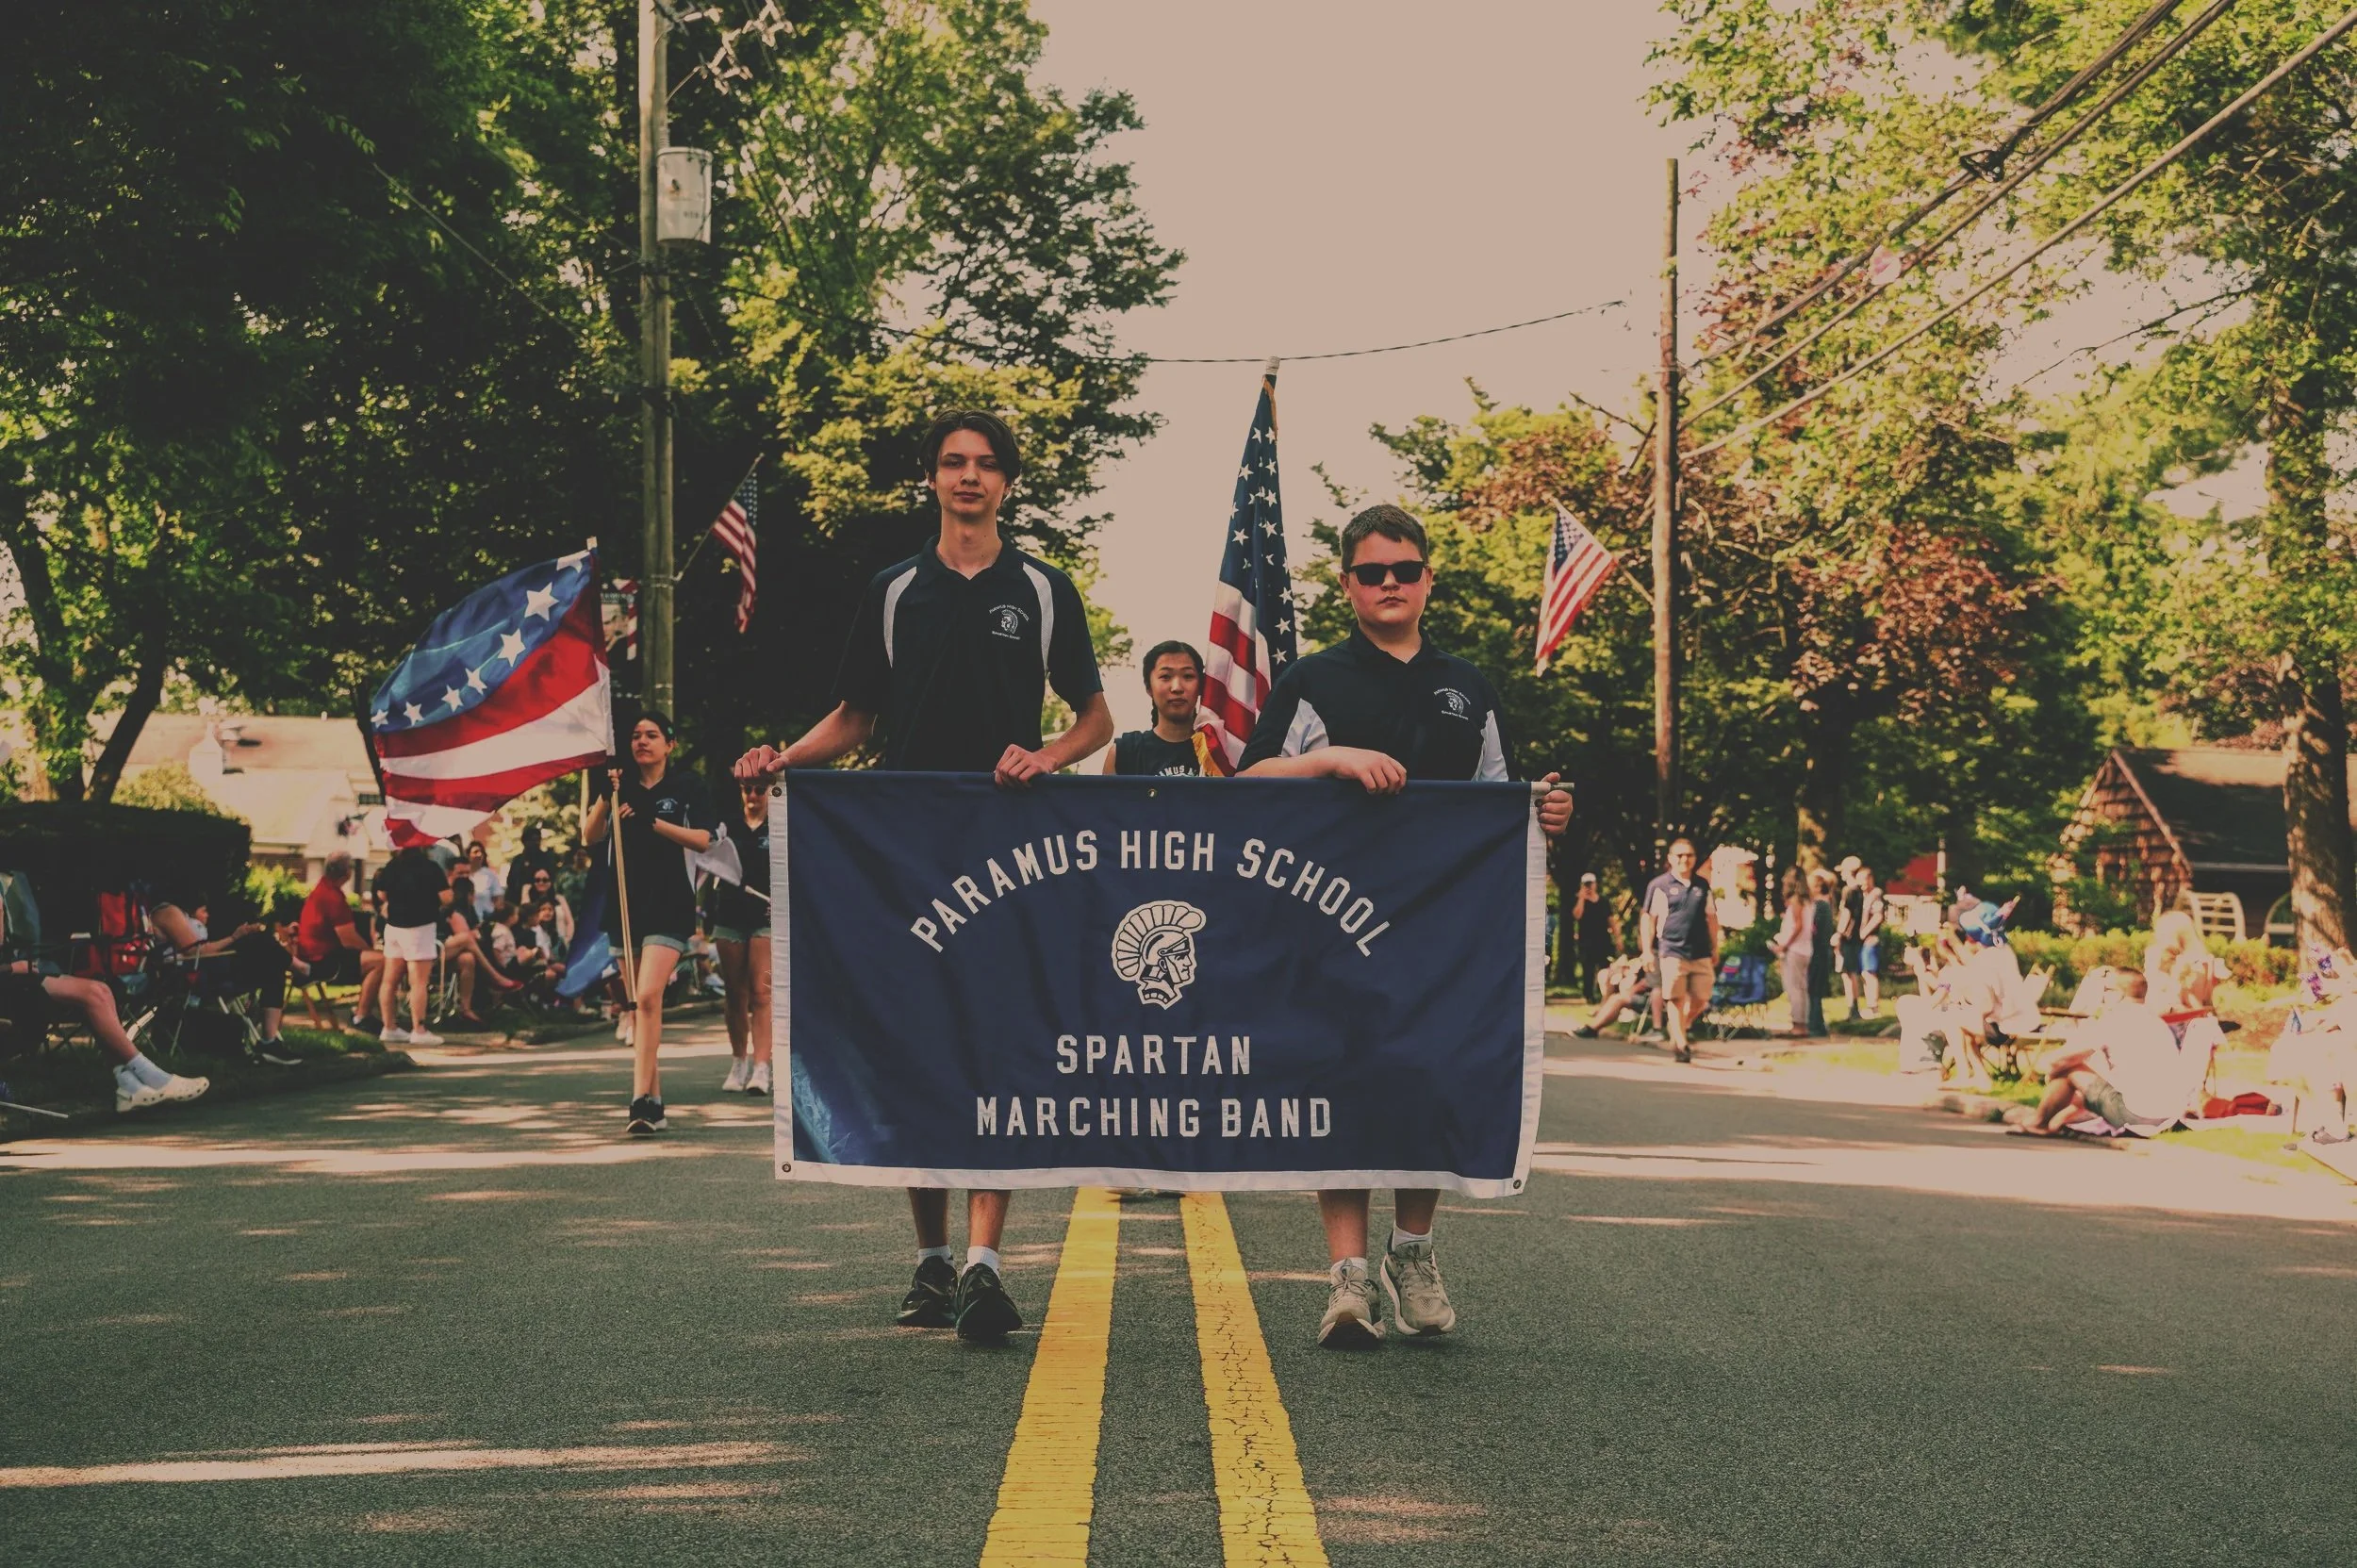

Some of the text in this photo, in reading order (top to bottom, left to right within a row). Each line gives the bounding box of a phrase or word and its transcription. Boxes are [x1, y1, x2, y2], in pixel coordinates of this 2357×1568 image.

[910, 829, 1391, 957] PARAMUS HIGH SCHOOL
[1056, 1034, 1251, 1075] SPARTAN
[977, 1096, 1331, 1138] MARCHING BAND
